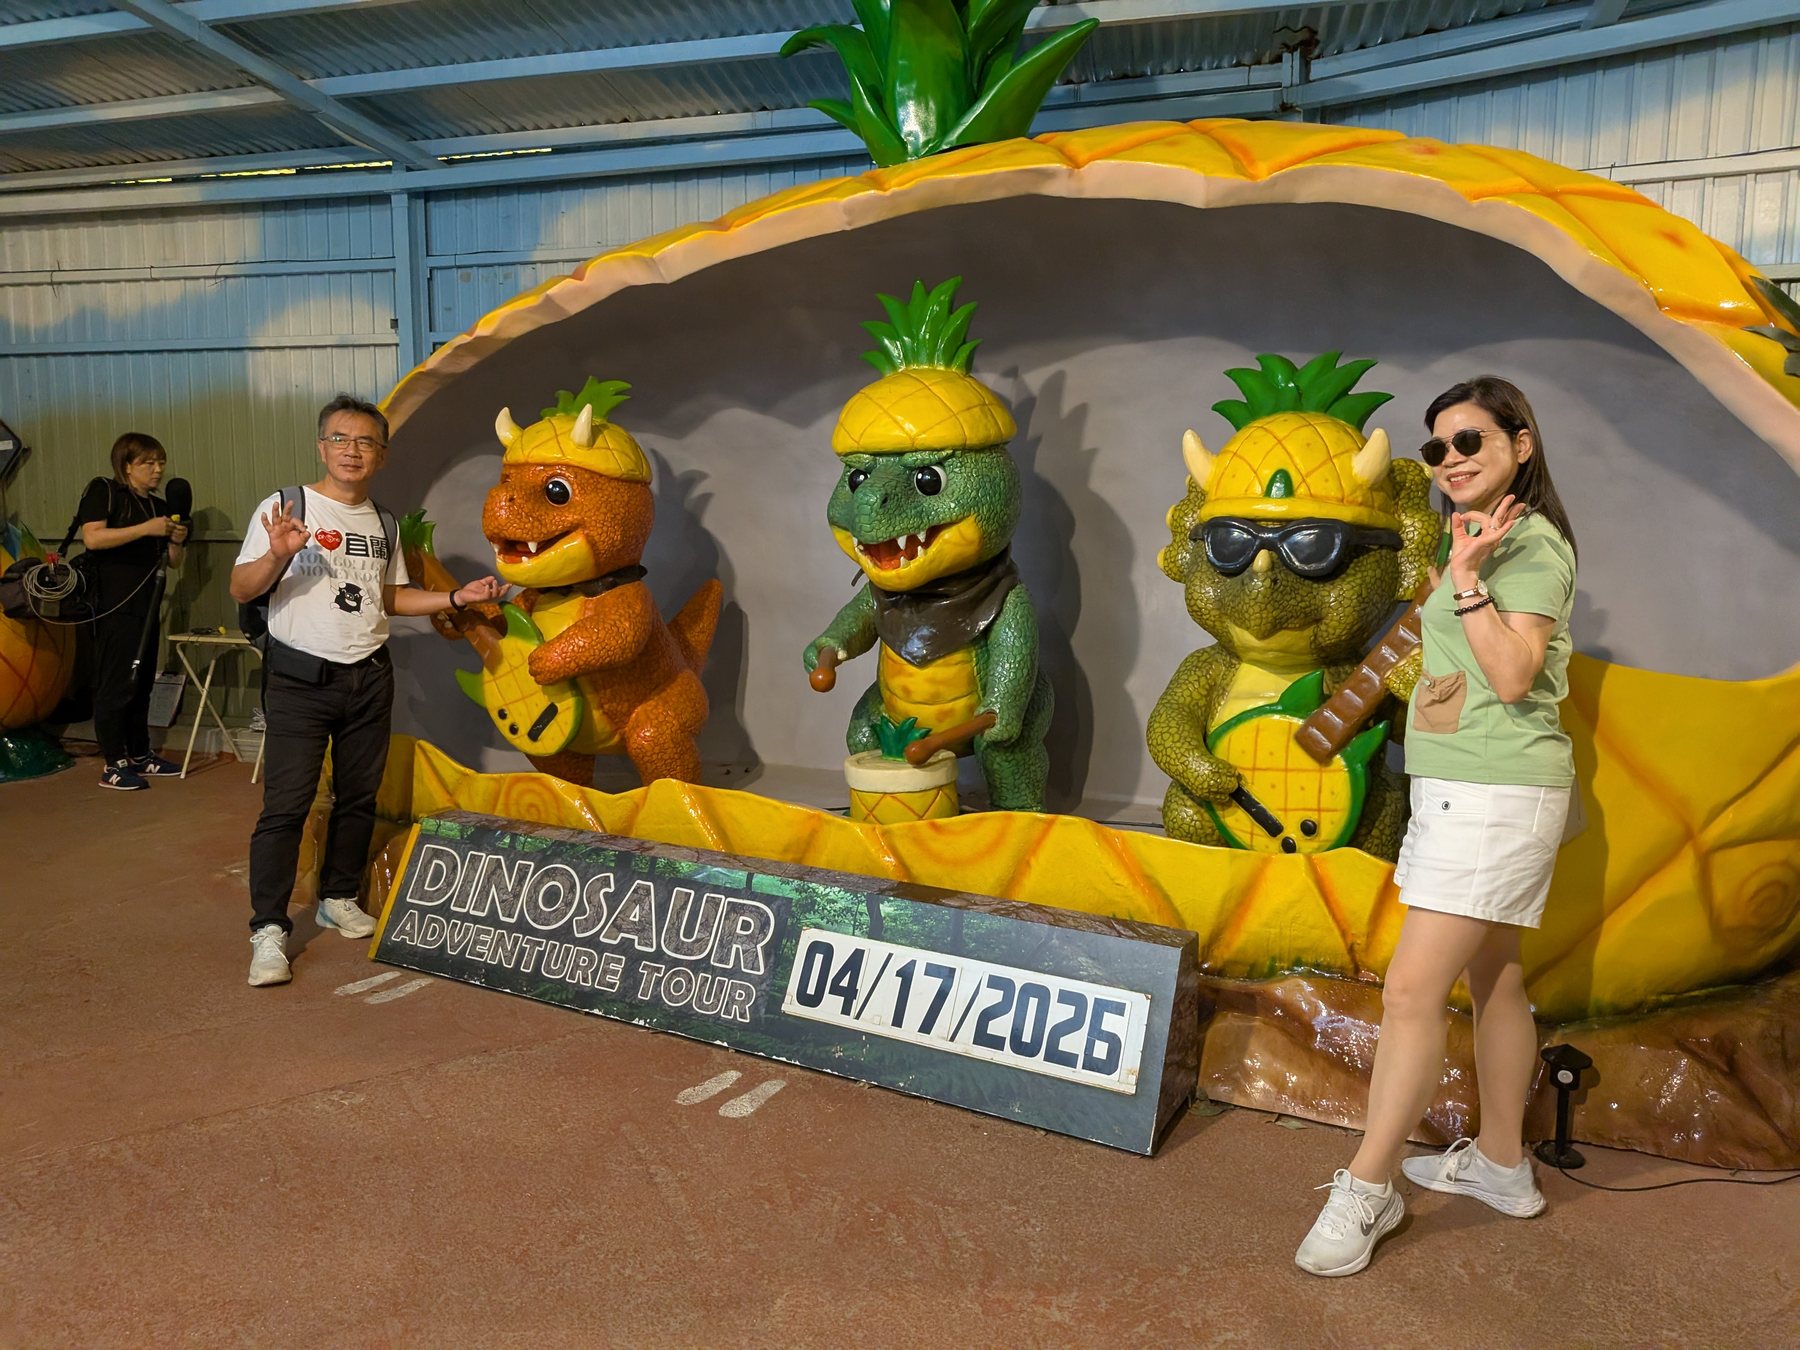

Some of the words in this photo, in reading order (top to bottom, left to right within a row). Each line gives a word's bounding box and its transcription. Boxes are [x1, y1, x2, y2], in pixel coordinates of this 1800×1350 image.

[108, 773, 121, 785] N
[145, 763, 161, 773] N
[391, 909, 626, 992] ADVENTURE
[637, 961, 757, 1023] TOUR
[406, 843, 776, 976] DINOSAUR
[795, 939, 1127, 1076] 04/17/2026
